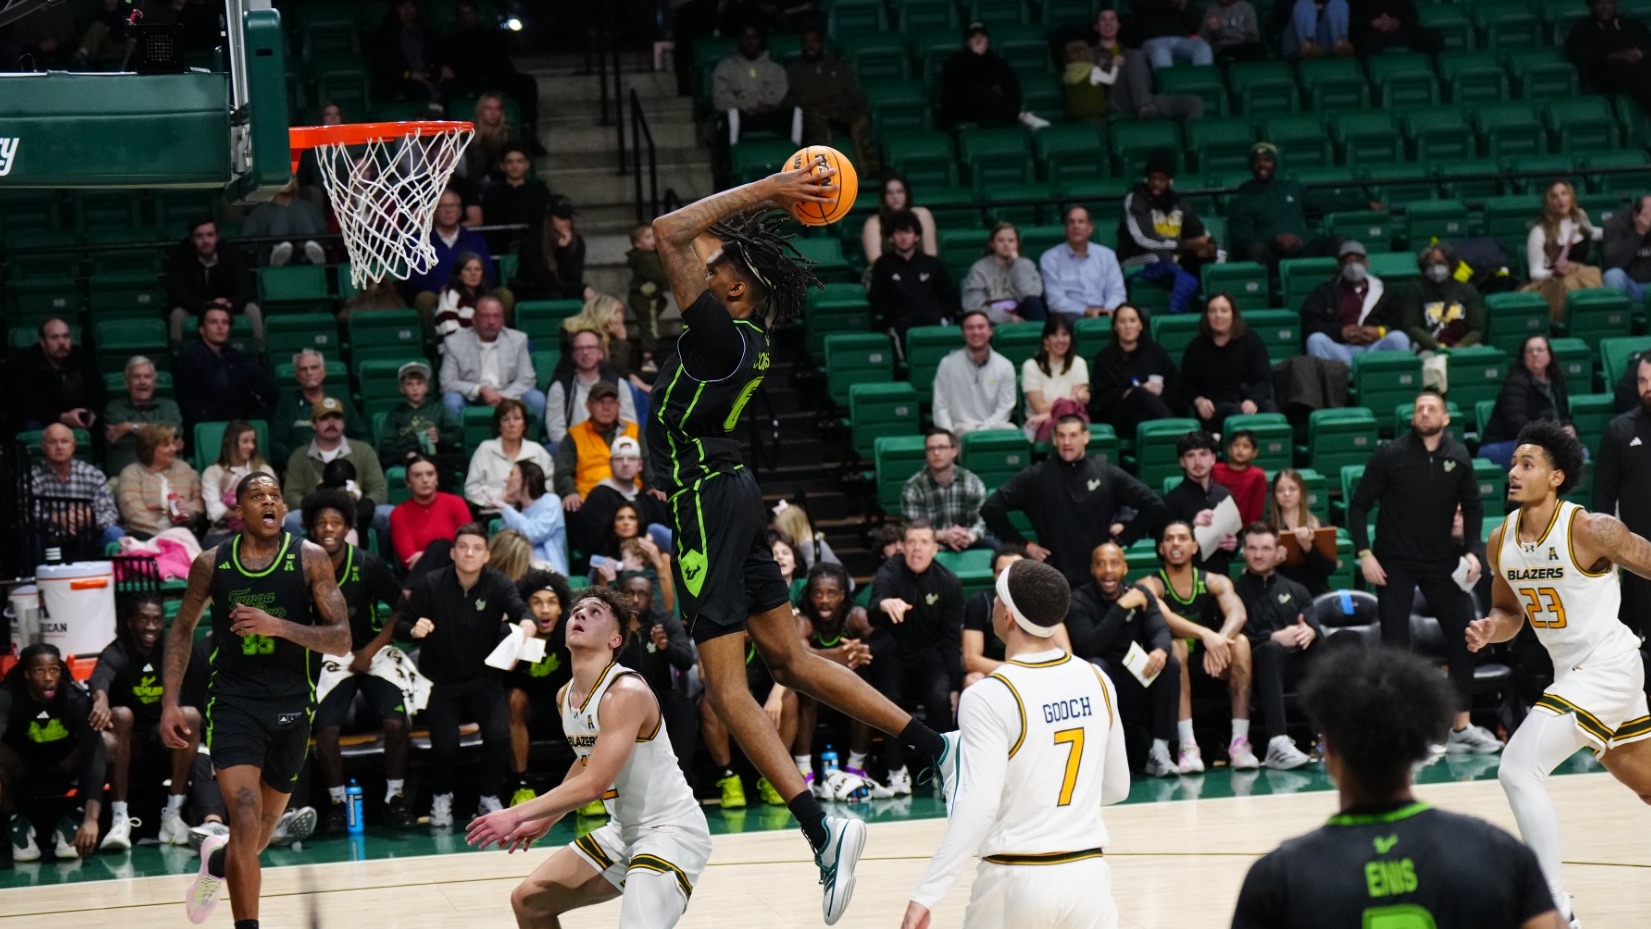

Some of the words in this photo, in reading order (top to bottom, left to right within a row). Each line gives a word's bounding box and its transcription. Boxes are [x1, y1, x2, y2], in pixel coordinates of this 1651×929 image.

[0, 137, 20, 177] y
[1507, 567, 1564, 581] BLAZERS
[1518, 587, 1567, 629] 23
[1042, 696, 1092, 723] GOOCH
[1053, 726, 1085, 807] 7
[1364, 857, 1418, 898] ENIS
